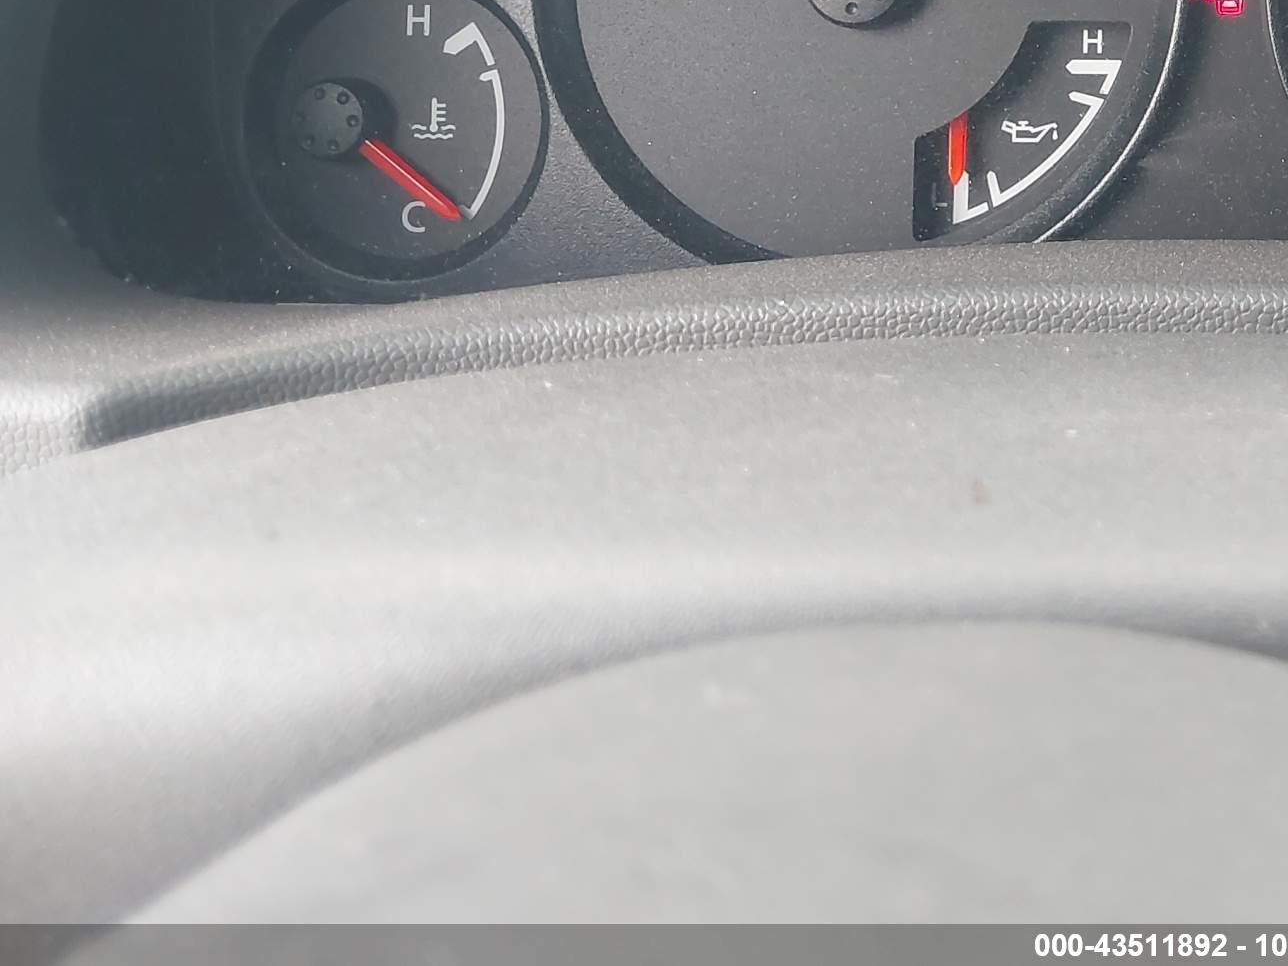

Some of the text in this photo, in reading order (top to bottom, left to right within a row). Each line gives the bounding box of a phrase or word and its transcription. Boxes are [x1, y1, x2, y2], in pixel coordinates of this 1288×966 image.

[407, 5, 431, 36] H
[1083, 31, 1103, 53] H
[402, 201, 426, 232] C
